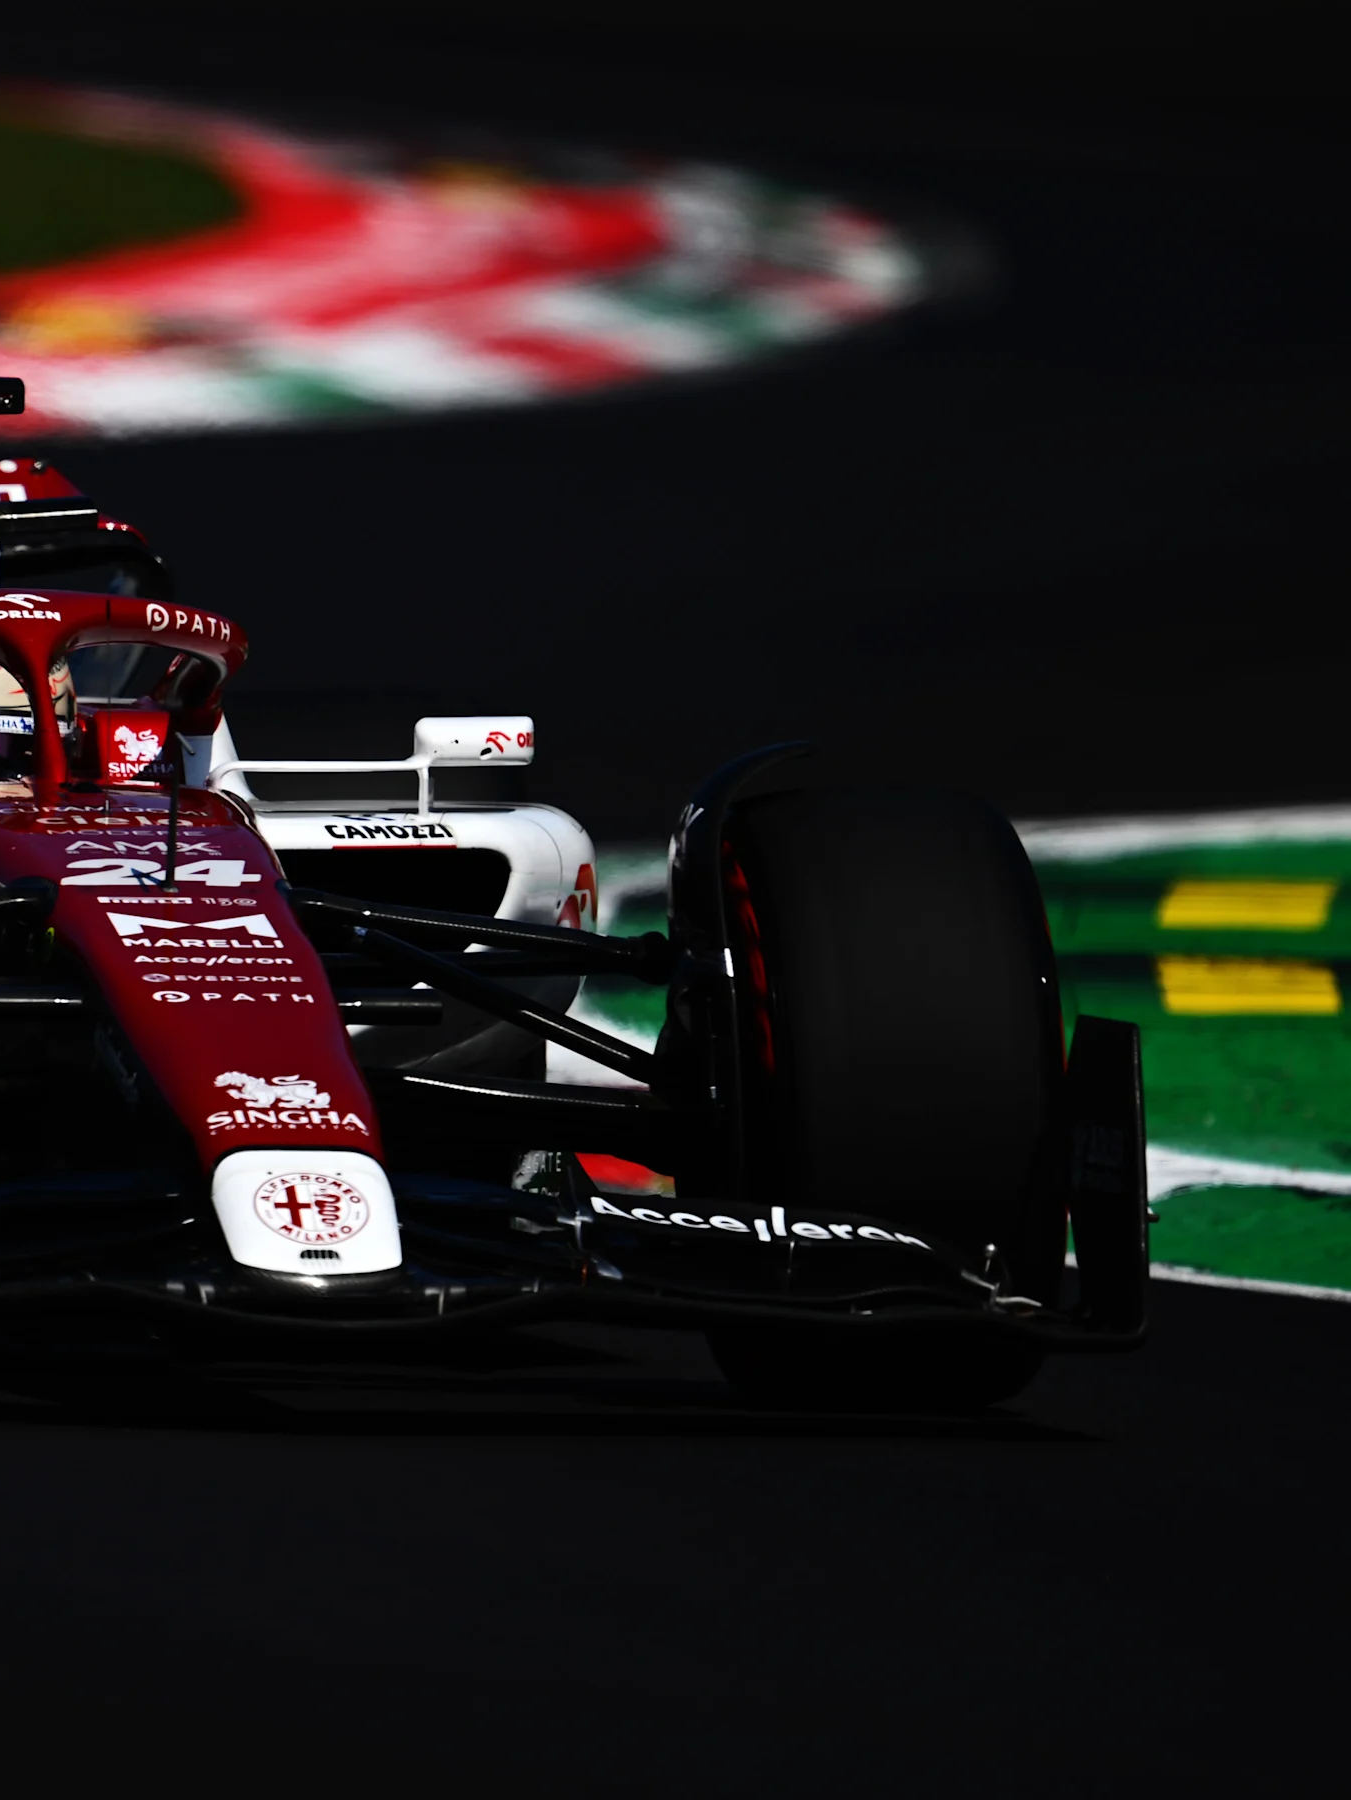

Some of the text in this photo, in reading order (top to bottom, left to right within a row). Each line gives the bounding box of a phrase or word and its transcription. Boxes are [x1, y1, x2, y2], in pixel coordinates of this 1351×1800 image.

[175, 610, 231, 643] PATH
[325, 823, 453, 839] CAMOZZI
[65, 840, 223, 853] AMX
[60, 858, 262, 888] 24
[120, 937, 285, 950] MARELLI
[133, 954, 294, 967] Accelleron
[201, 992, 316, 1004] PATH
[205, 1109, 368, 1131] SINGHA
[590, 1195, 937, 1253] Accelleron
